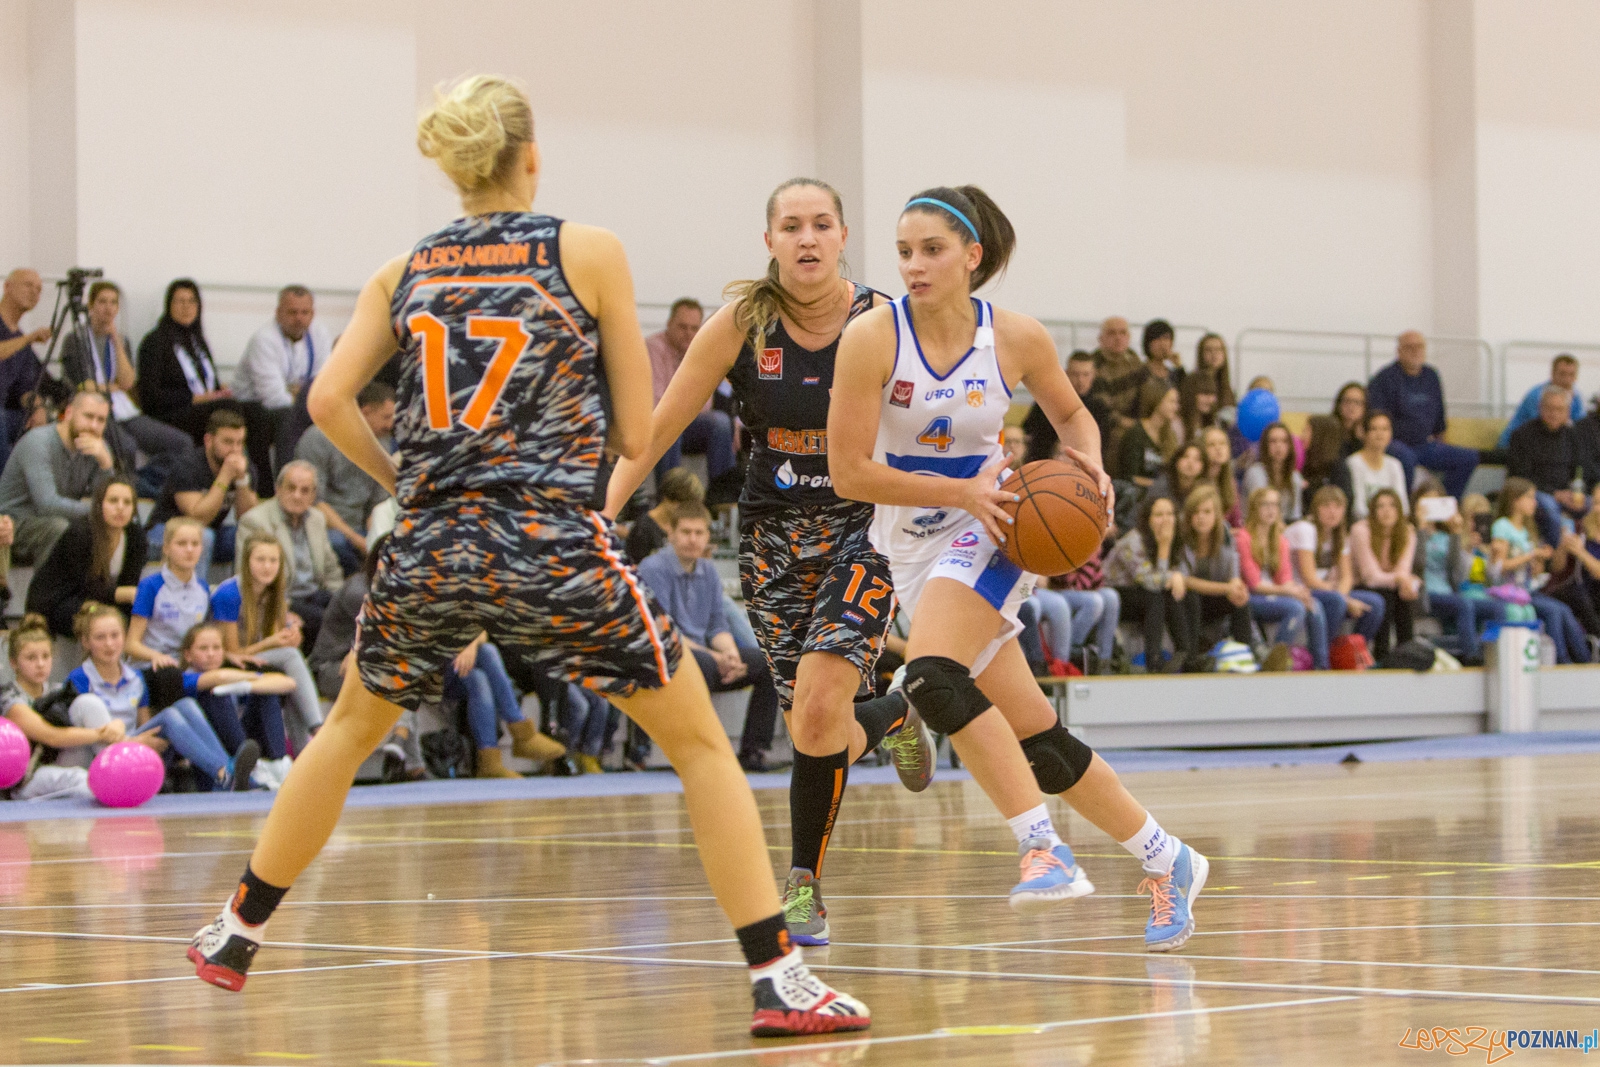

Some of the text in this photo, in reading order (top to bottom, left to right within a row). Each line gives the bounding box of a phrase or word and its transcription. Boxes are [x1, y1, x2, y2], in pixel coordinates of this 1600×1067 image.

[406, 311, 534, 434] 17
[916, 416, 955, 453] 4
[842, 563, 893, 619] 12
